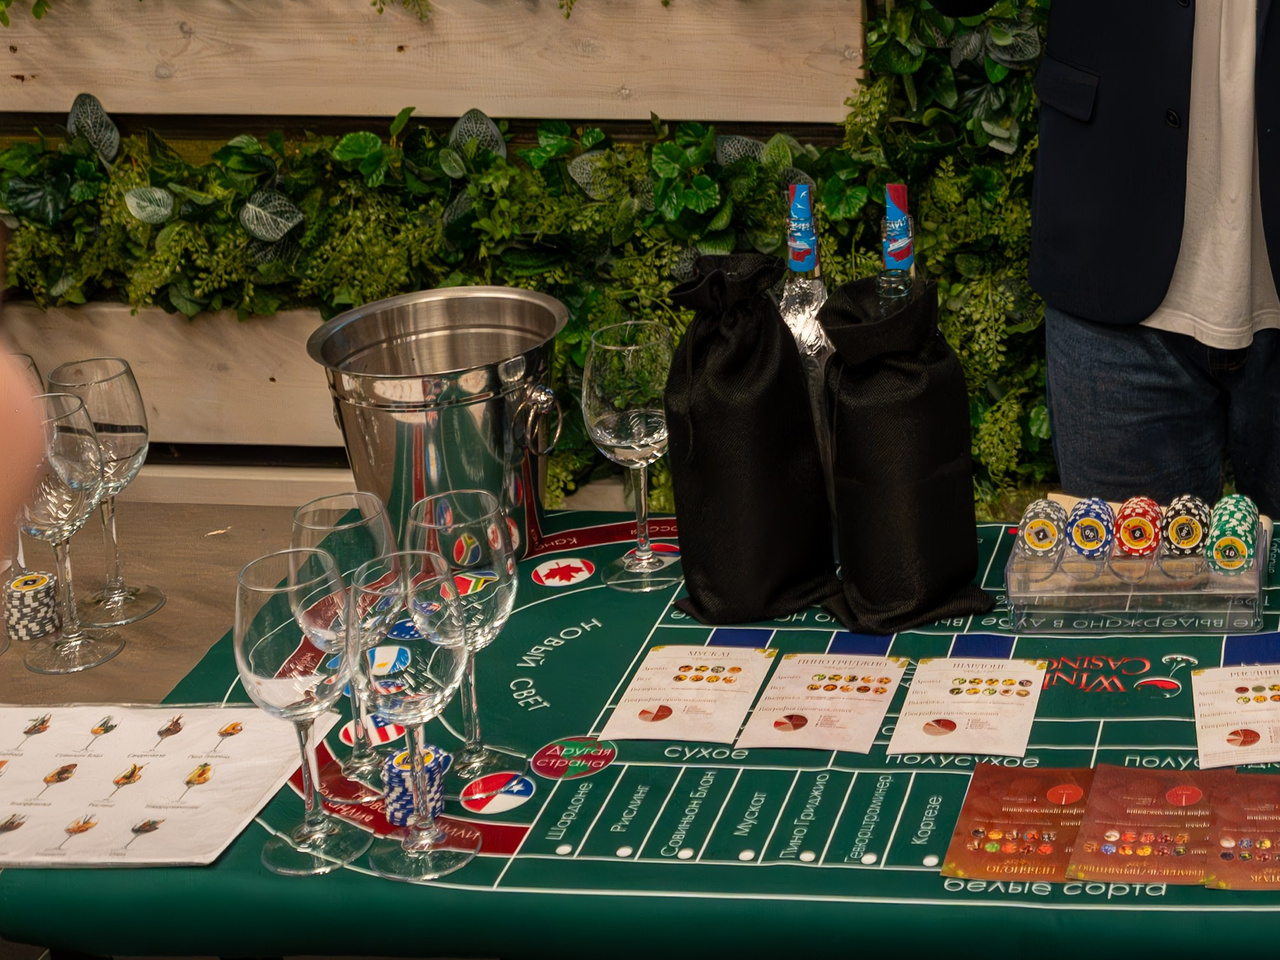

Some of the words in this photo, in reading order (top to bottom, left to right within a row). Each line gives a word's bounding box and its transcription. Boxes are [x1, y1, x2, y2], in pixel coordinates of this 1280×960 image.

[516, 616, 602, 669] НОВЫЙ
[1073, 616, 1224, 629] выдержано
[509, 677, 551, 713] СВЕТ
[536, 756, 605, 770] страна
[545, 744, 612, 760] Другая
[664, 745, 749, 761] сухое
[544, 781, 594, 841] Шардоне
[610, 784, 650, 833] Рислинг
[660, 800, 702, 857] Совиньон
[690, 770, 718, 800] Блан
[733, 791, 768, 837] Мускат
[793, 772, 830, 826] Гриджио
[911, 794, 943, 845] Кортезе
[779, 827, 808, 859] Пино
[944, 880, 1051, 897] белые
[1063, 881, 1167, 900] сорта
